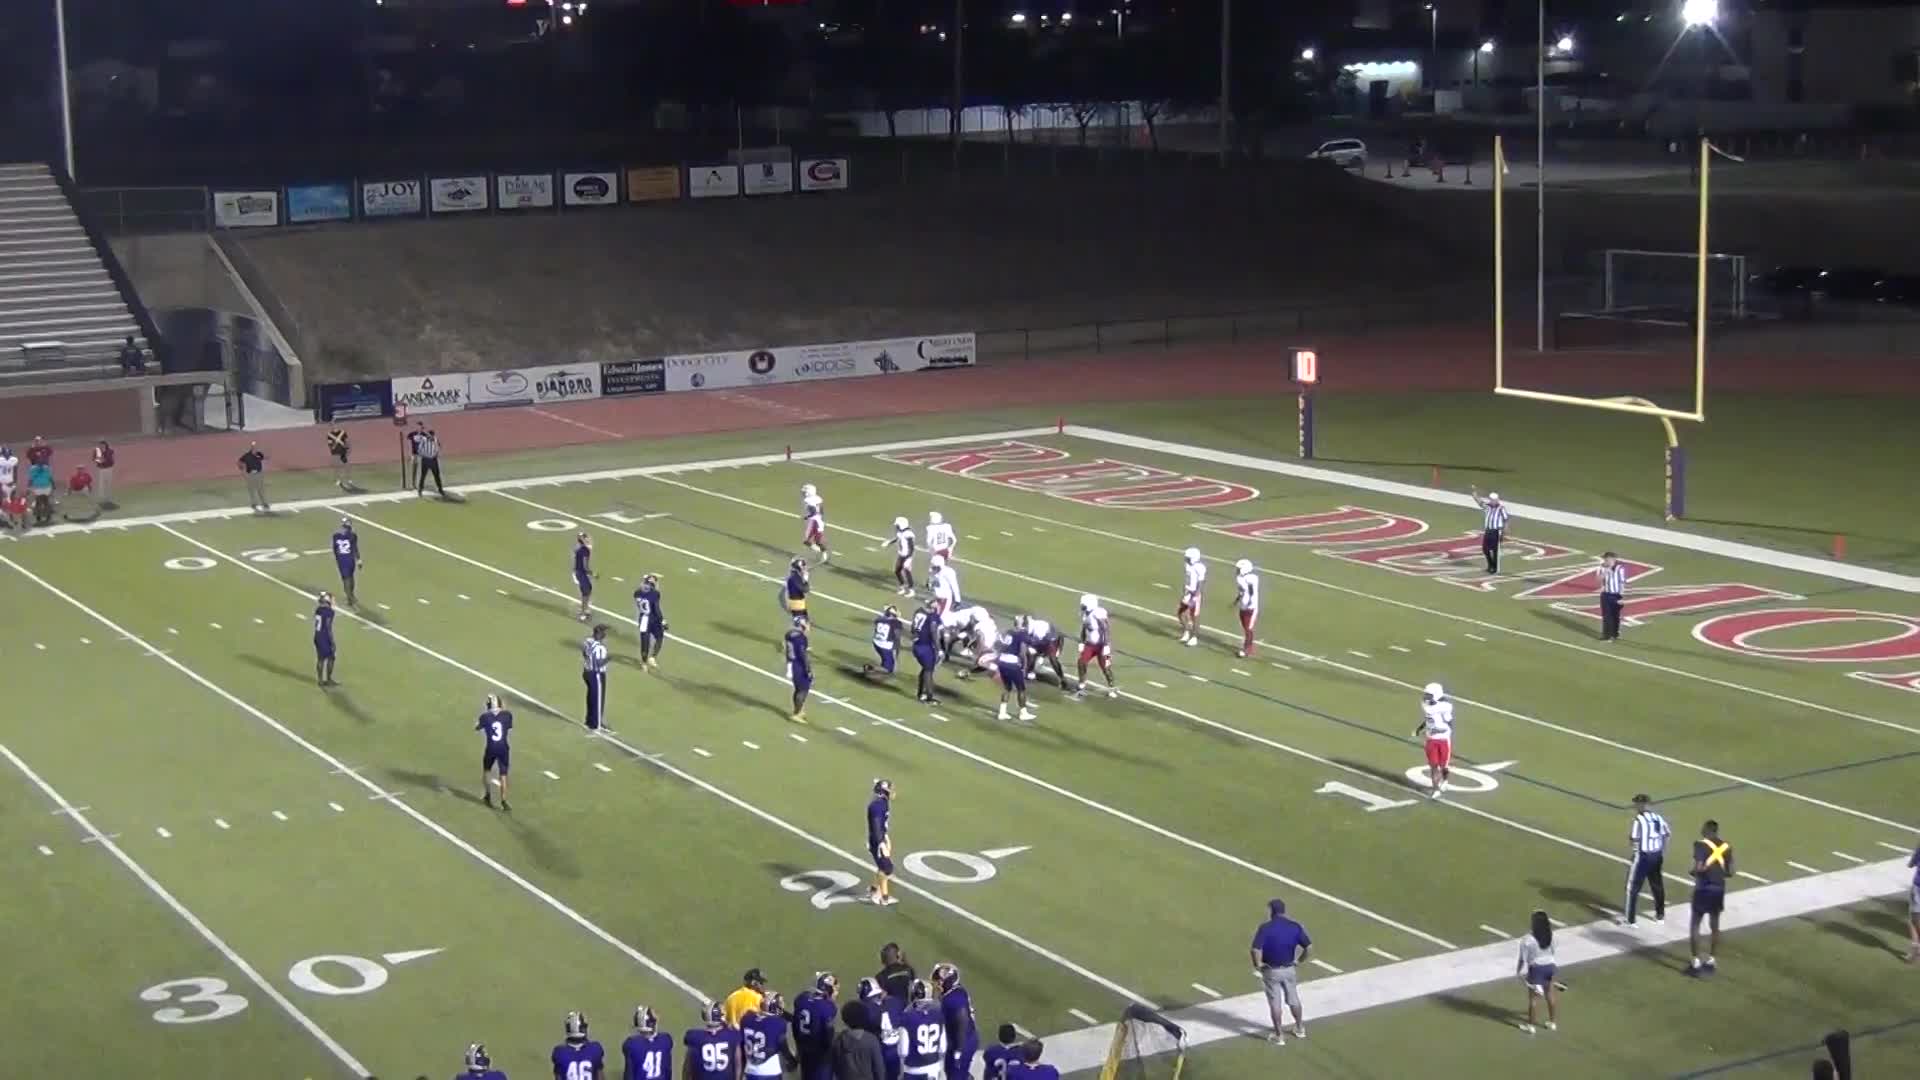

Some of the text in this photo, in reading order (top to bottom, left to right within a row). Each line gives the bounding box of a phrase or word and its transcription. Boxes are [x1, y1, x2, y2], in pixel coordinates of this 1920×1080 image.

[381, 182, 417, 198] JOY
[1297, 351, 1315, 381] 10
[395, 389, 461, 403] LANDMARK
[872, 441, 1920, 693] RED DEMO
[491, 721, 503, 741] 3
[800, 1009, 811, 1033] 2
[916, 1023, 940, 1054] 92
[642, 1051, 662, 1079] 41
[702, 1042, 729, 1071] 95
[566, 1060, 592, 1080] 46
